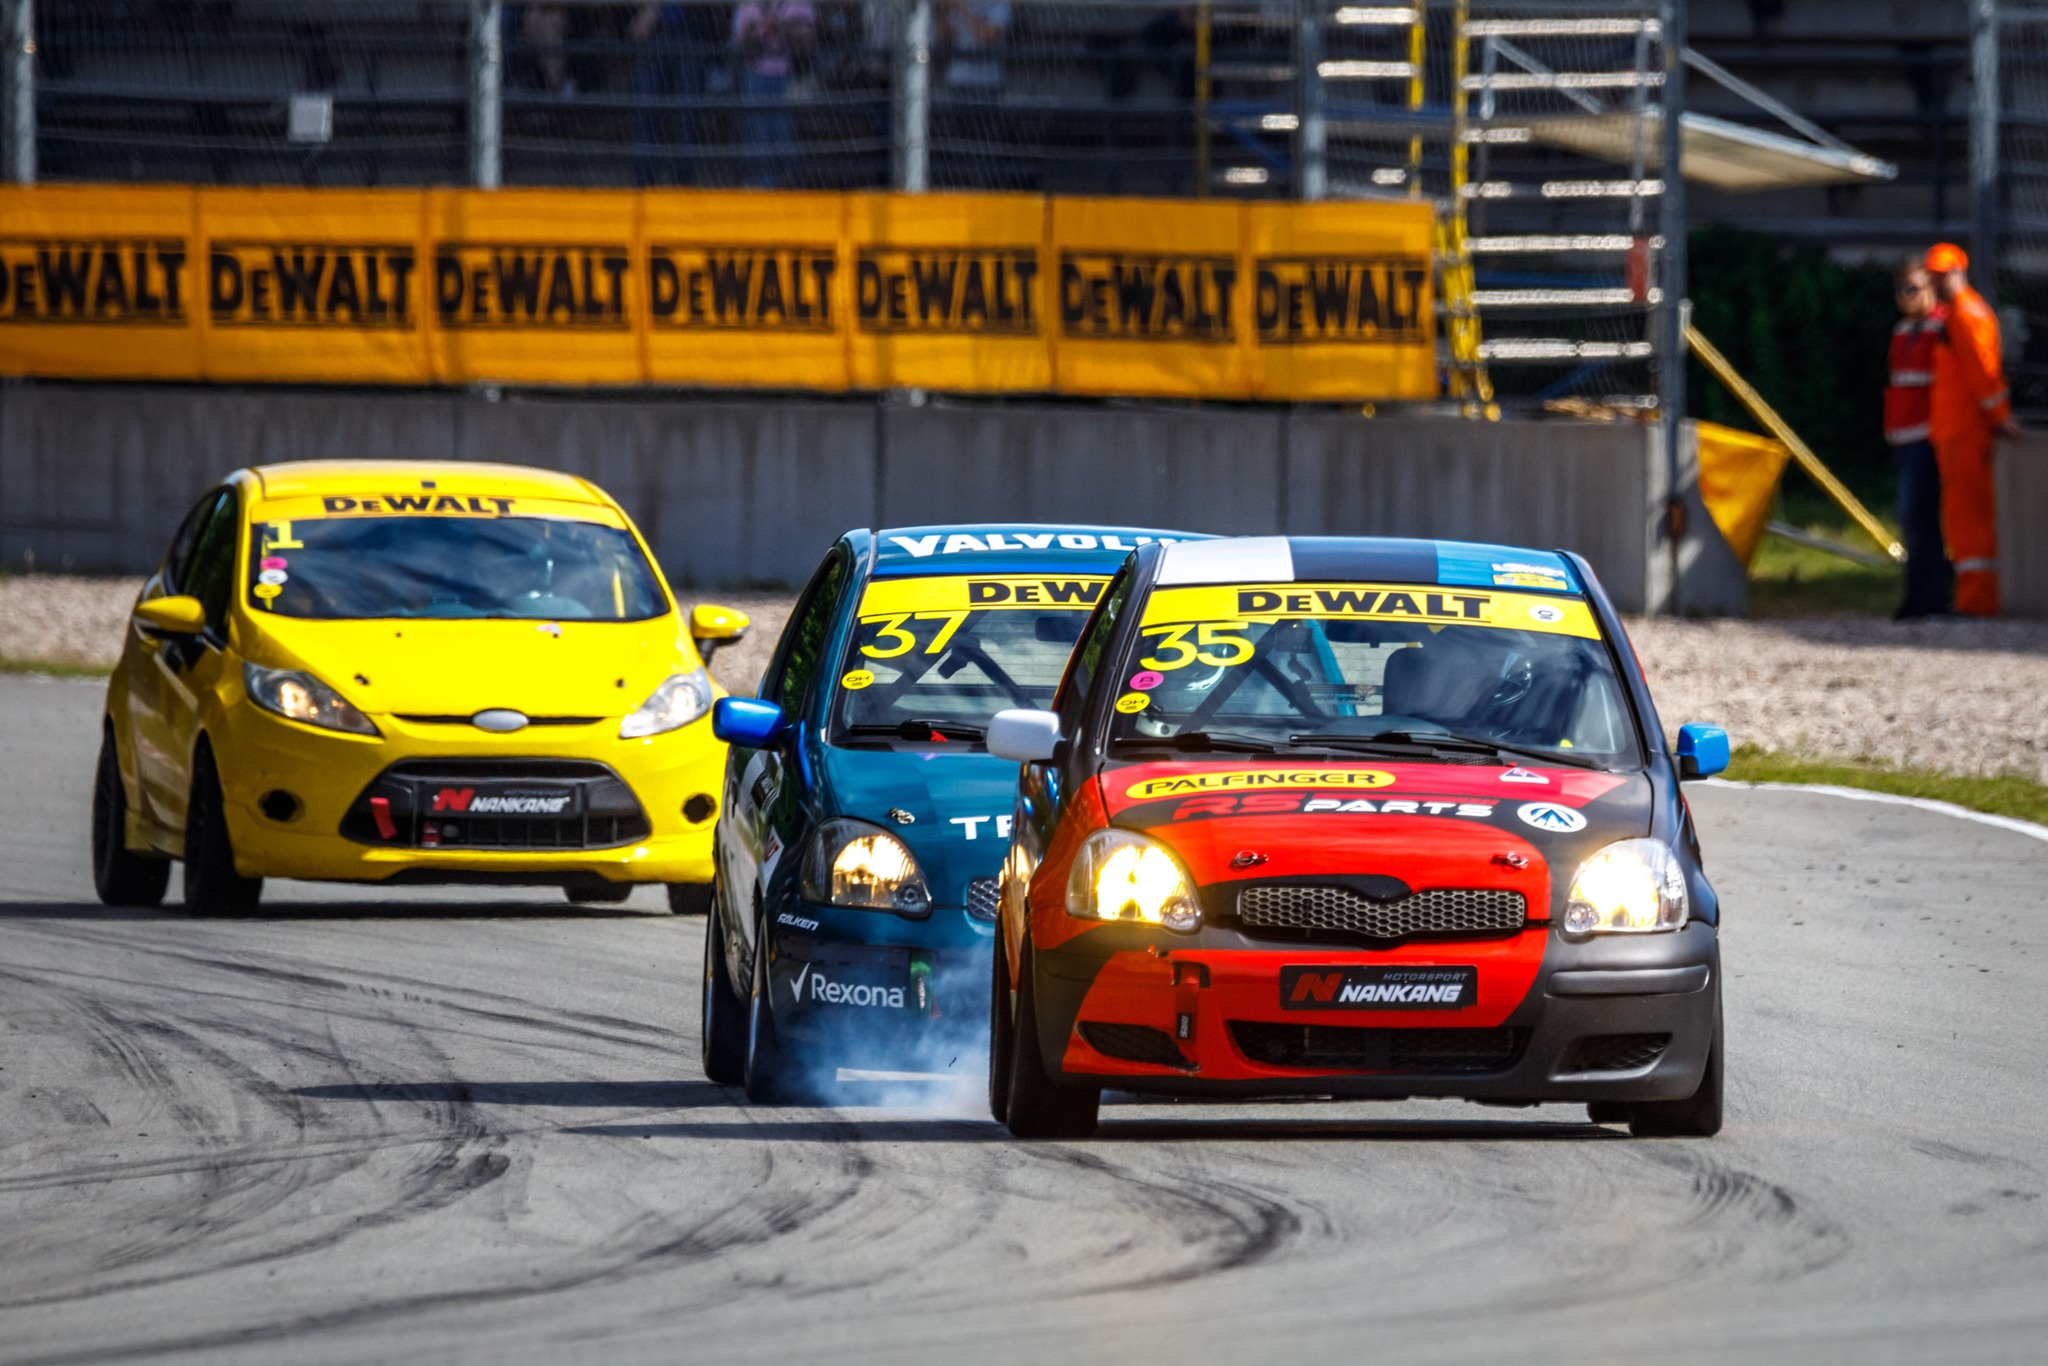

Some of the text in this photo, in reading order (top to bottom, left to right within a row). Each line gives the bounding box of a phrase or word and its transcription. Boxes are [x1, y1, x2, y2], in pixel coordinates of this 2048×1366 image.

[0, 251, 187, 310] EWALT
[267, 520, 304, 549] 1
[888, 533, 1188, 558] VALVOL
[860, 610, 972, 659] 37
[1140, 622, 1255, 671] 35
[1145, 772, 1376, 795] PALFINGER
[469, 797, 569, 813] NANKANG
[777, 912, 819, 931] FALKEN
[1383, 972, 1468, 982] MOTORSPORT
[811, 973, 904, 1008] Rexona
[1338, 984, 1463, 1003] NANKANG
